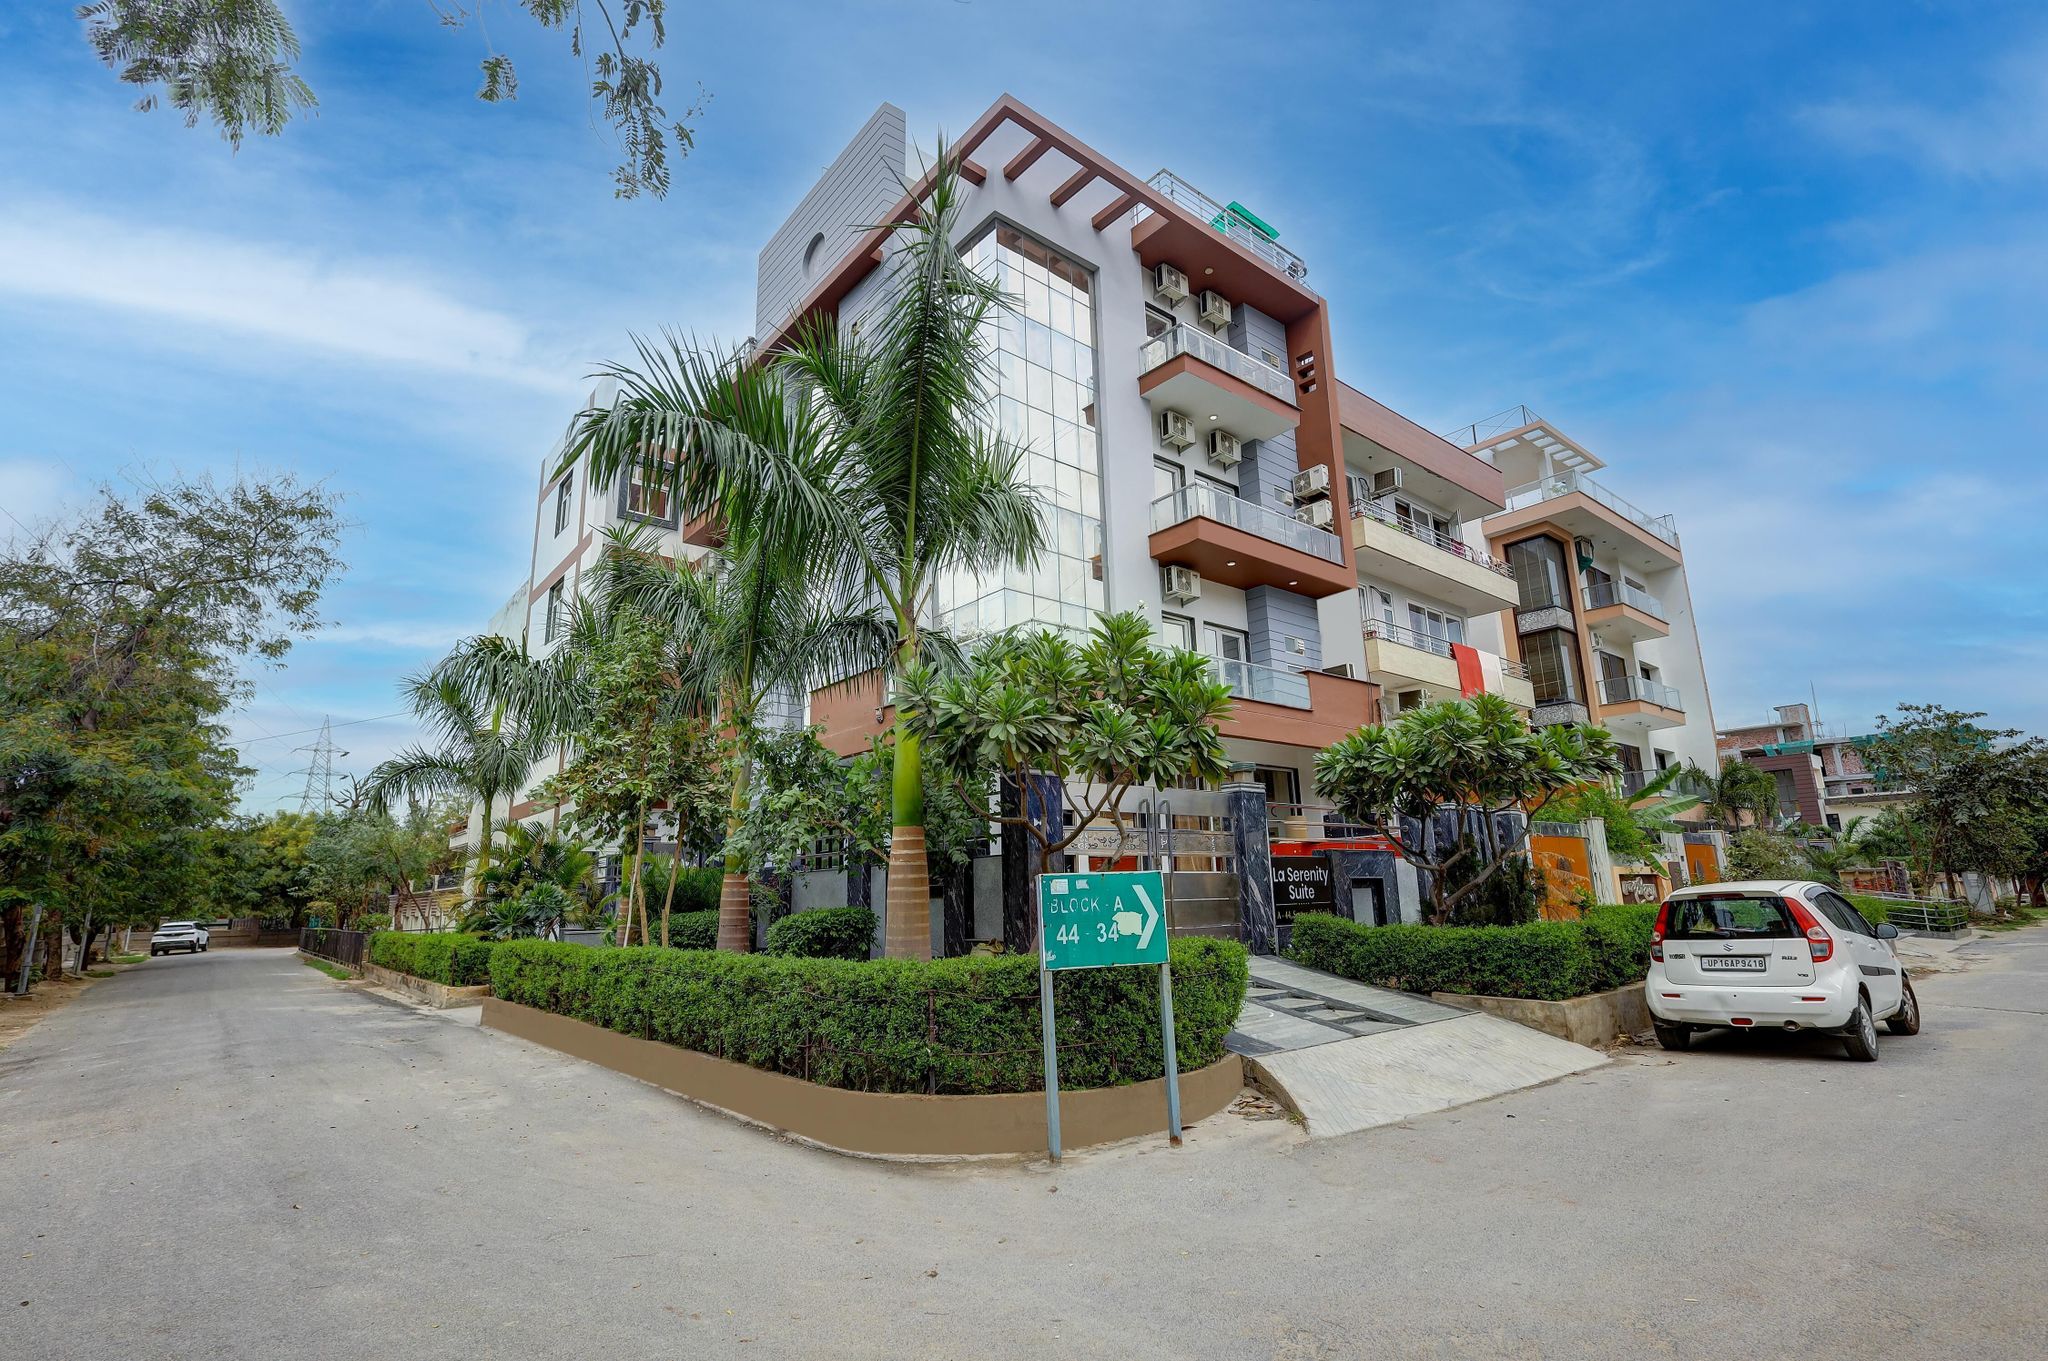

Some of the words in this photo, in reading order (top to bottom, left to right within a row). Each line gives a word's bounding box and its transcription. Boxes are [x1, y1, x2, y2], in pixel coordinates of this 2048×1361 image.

[1273, 867, 1285, 882] La
[1287, 866, 1328, 886] Serenity
[1289, 884, 1315, 900] Suite
[1050, 897, 1099, 913] BLOCK
[1114, 896, 1124, 911] A
[1056, 924, 1080, 944] 44
[1096, 922, 1119, 942] 34
[1707, 959, 1764, 968] UP16AP9418
